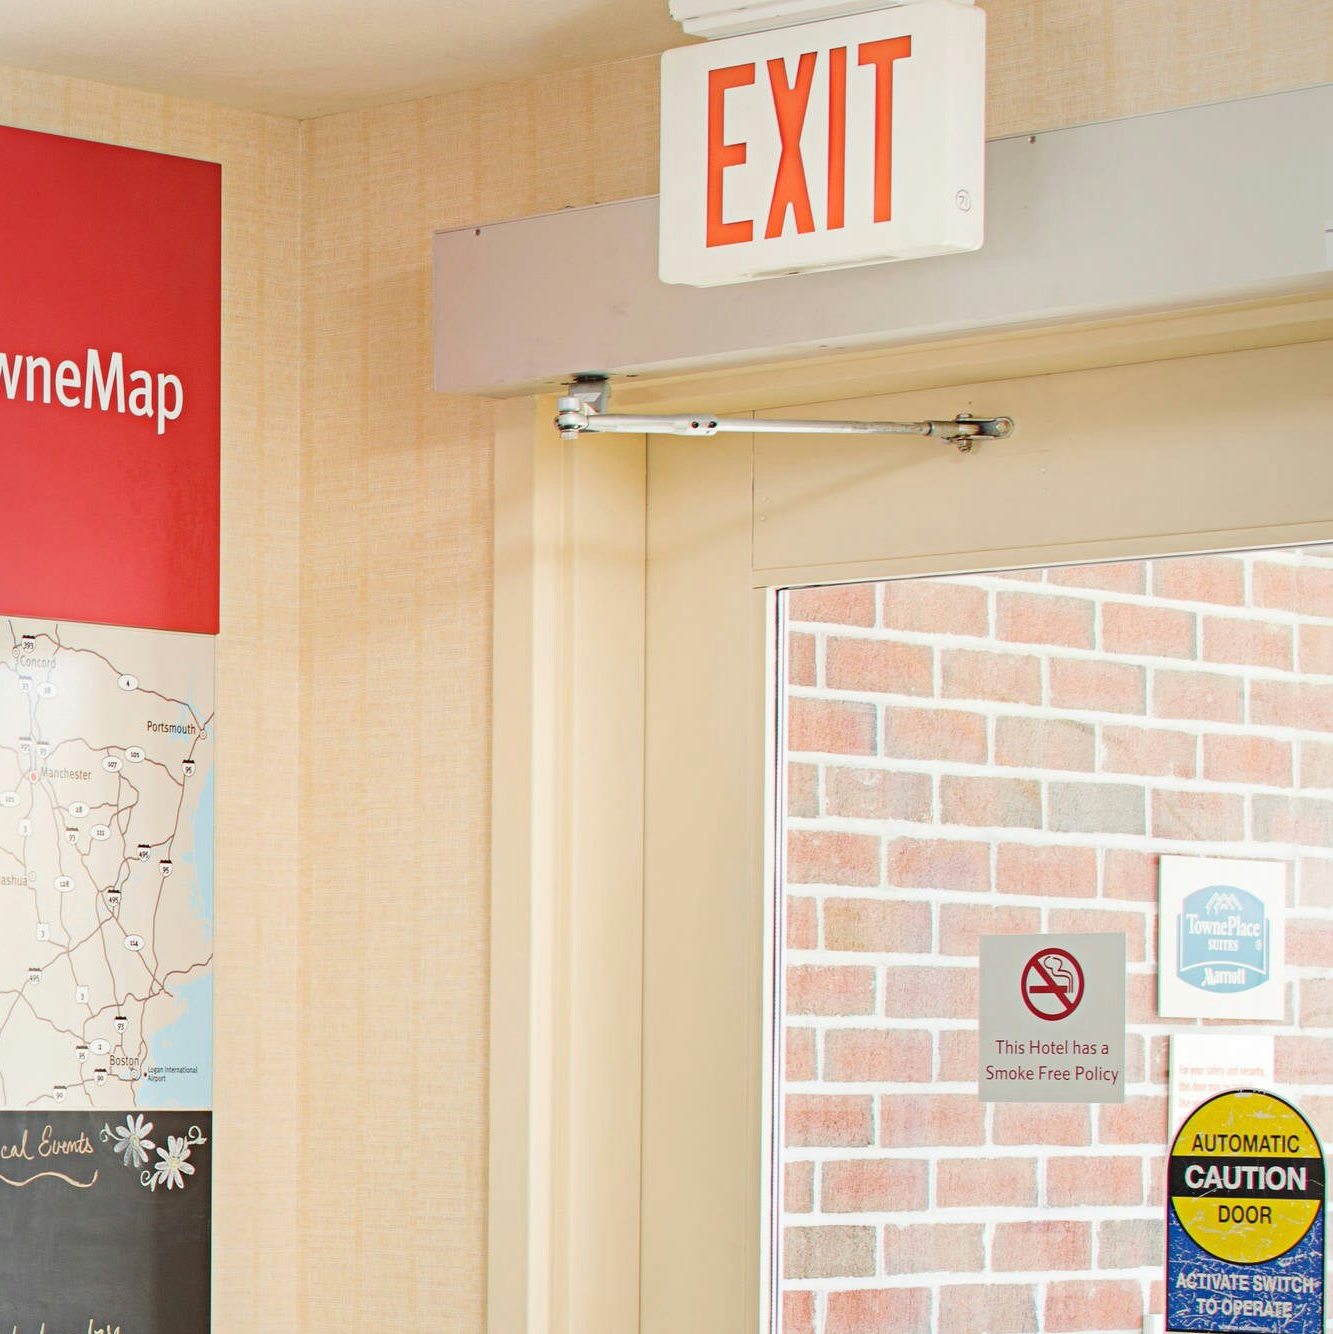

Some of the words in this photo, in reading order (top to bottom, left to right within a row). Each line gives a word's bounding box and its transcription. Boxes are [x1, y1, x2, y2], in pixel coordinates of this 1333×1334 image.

[706, 35, 912, 248] EXIT
[20, 655, 56, 668] Concord
[147, 721, 196, 735] Portsmouth
[41, 767, 92, 781] Manchester
[1186, 913, 1261, 937] TownePlace
[1207, 939, 1239, 952] SUITES
[1201, 967, 1246, 987] Marriott
[995, 1040, 1025, 1055] This
[1029, 1040, 1068, 1055] Hotel
[1072, 1040, 1097, 1055] has
[1101, 1043, 1109, 1055] a
[109, 1055, 140, 1066] Boston
[147, 1066, 163, 1074] Logan
[164, 1065, 198, 1074] International
[986, 1066, 1034, 1080] Smoke
[1038, 1066, 1071, 1080] Free
[1075, 1066, 1119, 1085] Policy
[38, 1125, 94, 1158] Events
[1192, 1134, 1299, 1153] AUTOMATIC
[1185, 1165, 1305, 1191] CAUTION
[1218, 1205, 1271, 1224] DOOR
[1176, 1273, 1250, 1291] ACTIVATE
[1253, 1276, 1314, 1293] SWITCH
[1197, 1299, 1217, 1314] TO
[1220, 1300, 1293, 1318] OPERATE
